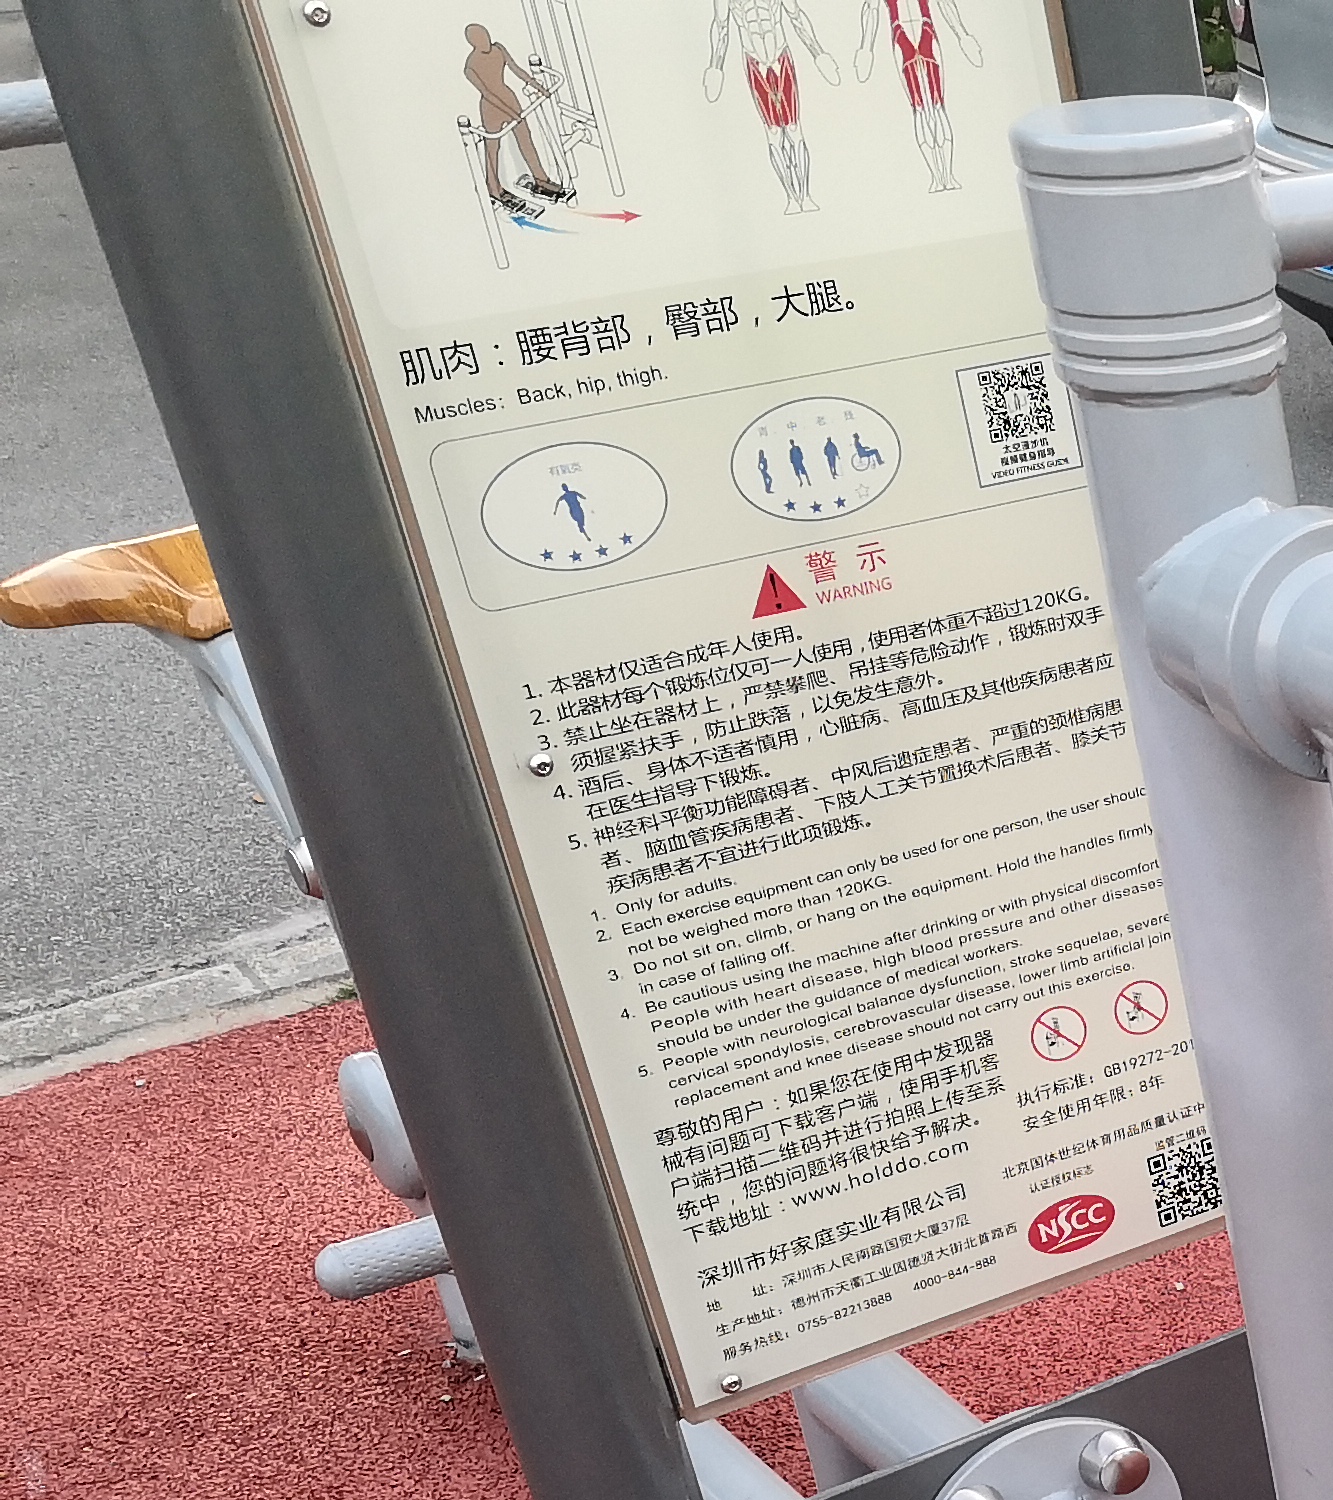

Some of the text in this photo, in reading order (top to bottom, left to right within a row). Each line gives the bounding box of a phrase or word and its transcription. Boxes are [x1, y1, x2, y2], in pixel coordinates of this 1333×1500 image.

[516, 382, 572, 405] Back,
[576, 376, 612, 396] hip,
[616, 365, 668, 387] thigh.
[991, 468, 1015, 479] VIDEO
[1015, 461, 1045, 474] FITNESS
[815, 576, 892, 605] WARNING
[521, 683, 543, 700] 1.
[529, 708, 550, 725] 2.
[537, 734, 558, 751] 3.
[553, 784, 573, 800] 4.
[567, 833, 588, 850] 5.
[595, 786, 1146, 942] 2. Each exercise equipment can only be used for one person, the user should
[590, 877, 737, 922] 1. Only for adults.
[607, 822, 1153, 981] 3. Do not sit on, climb, or hang on the equipment. Hold the handles firmly
[627, 875, 892, 955] not be weighed more than 120KG.
[620, 1007, 636, 1020] 4.
[644, 1000, 667, 1013] Be
[672, 980, 738, 1005] cautious
[741, 967, 784, 985] using
[787, 959, 812, 973] the
[816, 940, 880, 965] machine
[884, 928, 917, 945] after
[921, 912, 977, 935] drinking
[981, 906, 995, 918] or
[998, 896, 1027, 913] with
[1031, 878, 1087, 907] physical
[638, 941, 795, 994] in case of falling off.
[650, 878, 1163, 1033] People with heart disease, high blood pressure and other diseases
[637, 1064, 654, 1077] 5.
[662, 1046, 718, 1071] People
[722, 1035, 755, 1051] with
[760, 1004, 852, 1042] neurological
[856, 989, 915, 1013] balance
[919, 964, 1006, 995] dysfunction,
[1009, 948, 1052, 968] stroke
[1056, 929, 1123, 954] sequelae,
[656, 939, 1023, 1051] should be under the guidance of medical workers.
[668, 1060, 729, 1088] cervical
[733, 1035, 829, 1069] spondylosis,
[833, 997, 951, 1039] cerebrovascular
[955, 980, 1015, 1003] disease,
[1018, 965, 1056, 984] lower
[1059, 955, 1089, 972] limb
[1092, 937, 1144, 962] artificial
[674, 962, 1134, 1108] replacement and knee disease should not carry out this exercise.
[1037, 1200, 1107, 1244] NSCC
